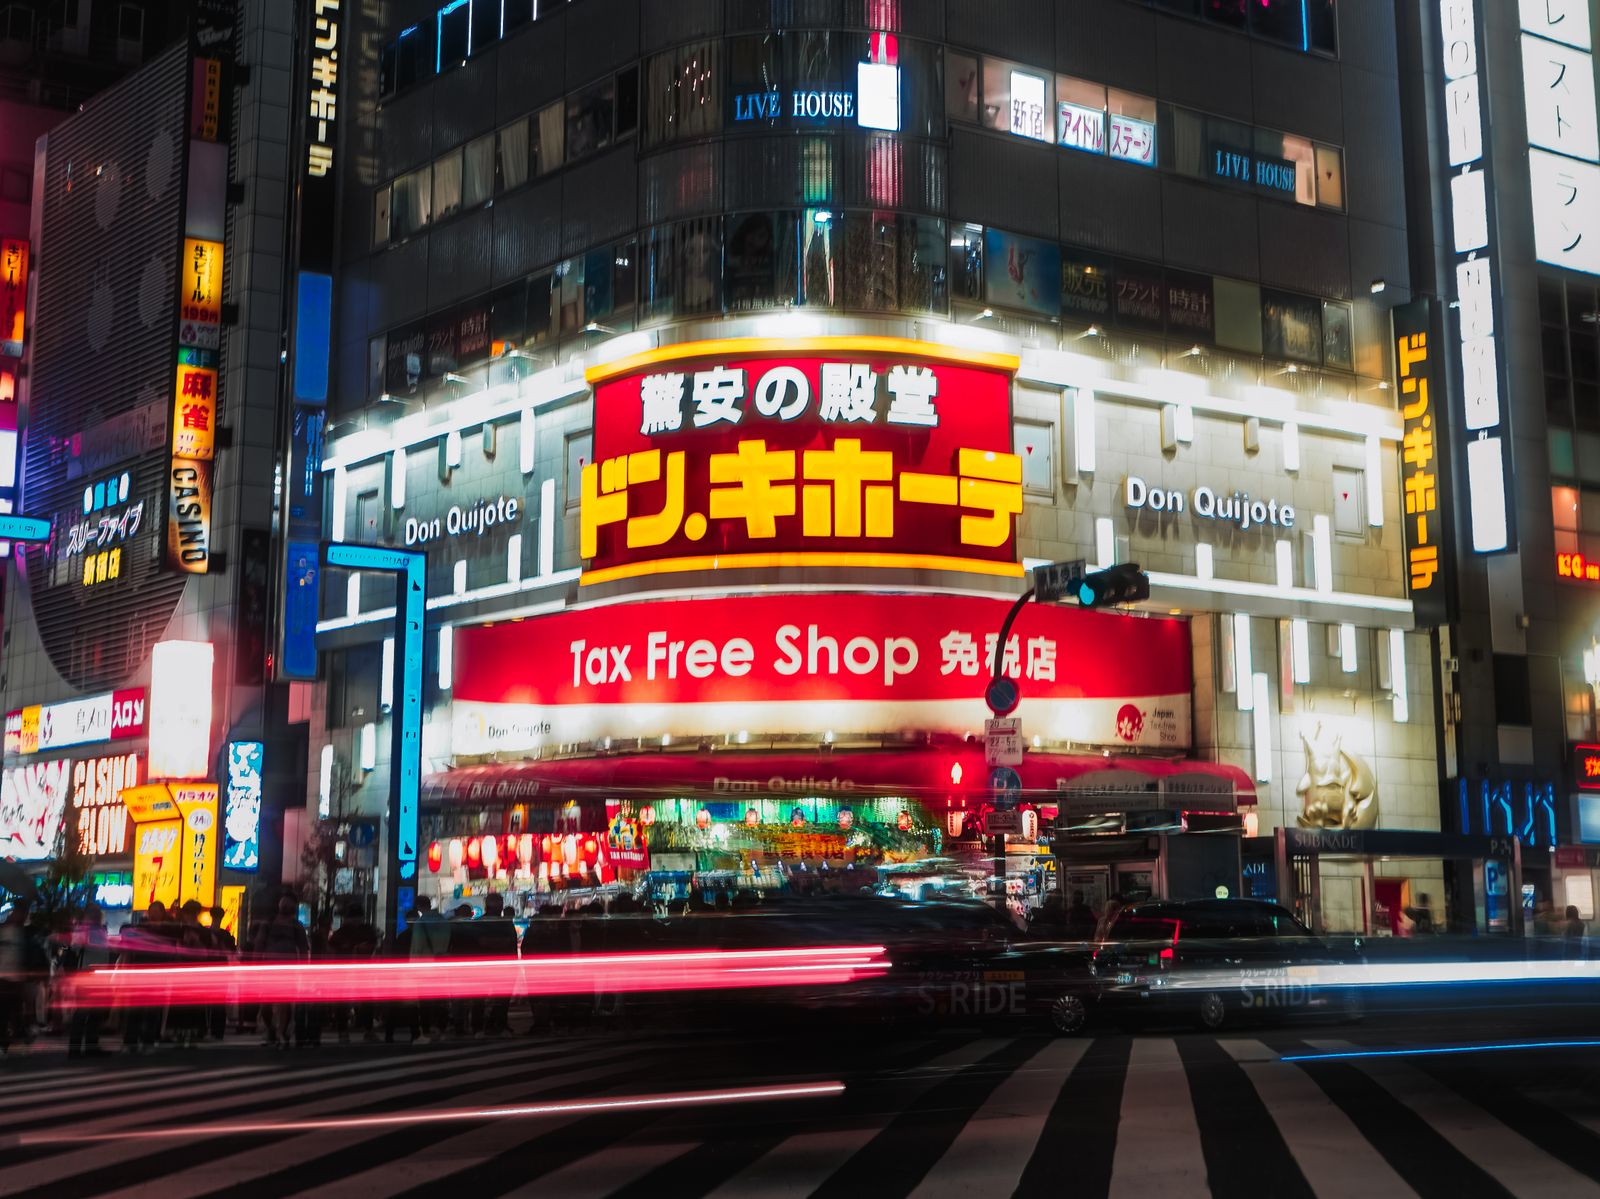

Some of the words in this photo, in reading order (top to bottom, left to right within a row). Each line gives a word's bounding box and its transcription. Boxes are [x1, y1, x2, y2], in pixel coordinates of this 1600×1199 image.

[734, 91, 781, 121] LIVE
[792, 90, 855, 119] HOUSE
[1011, 97, 1044, 141] 新宿
[1060, 109, 1103, 152] アイドル
[1109, 123, 1154, 160] ステージ
[1215, 150, 1250, 182] LIVE
[1256, 160, 1295, 192] HOUSE
[191, 245, 206, 304] 生ビール
[1116, 279, 1160, 304] ブランド
[1169, 287, 1210, 312] 時計
[182, 372, 212, 432] 麻雀
[638, 361, 939, 435] 驚安の殿堂
[172, 466, 208, 566] CASINO
[404, 513, 441, 546] Don
[446, 495, 519, 538] Quijote
[1126, 475, 1184, 514] Don
[1194, 486, 1296, 530] Quijote
[66, 500, 144, 558] スリーファイブ
[83, 547, 121, 586] 新宿店
[569, 638, 632, 688] Tax
[646, 630, 755, 681] Free
[773, 624, 919, 687] Shop
[939, 629, 1057, 683] 免税店
[512, 720, 551, 737] jote
[1160, 731, 1177, 742] Shop
[176, 790, 216, 803] カラオケ
[470, 782, 494, 799] Don
[496, 779, 540, 799] Quijote
[714, 775, 758, 793] Don
[768, 774, 855, 794] Quijote
[1294, 833, 1358, 849] SUBNADE
[917, 981, 1027, 1016] S.RIDE
[1240, 977, 1320, 1009] S.RIDE
